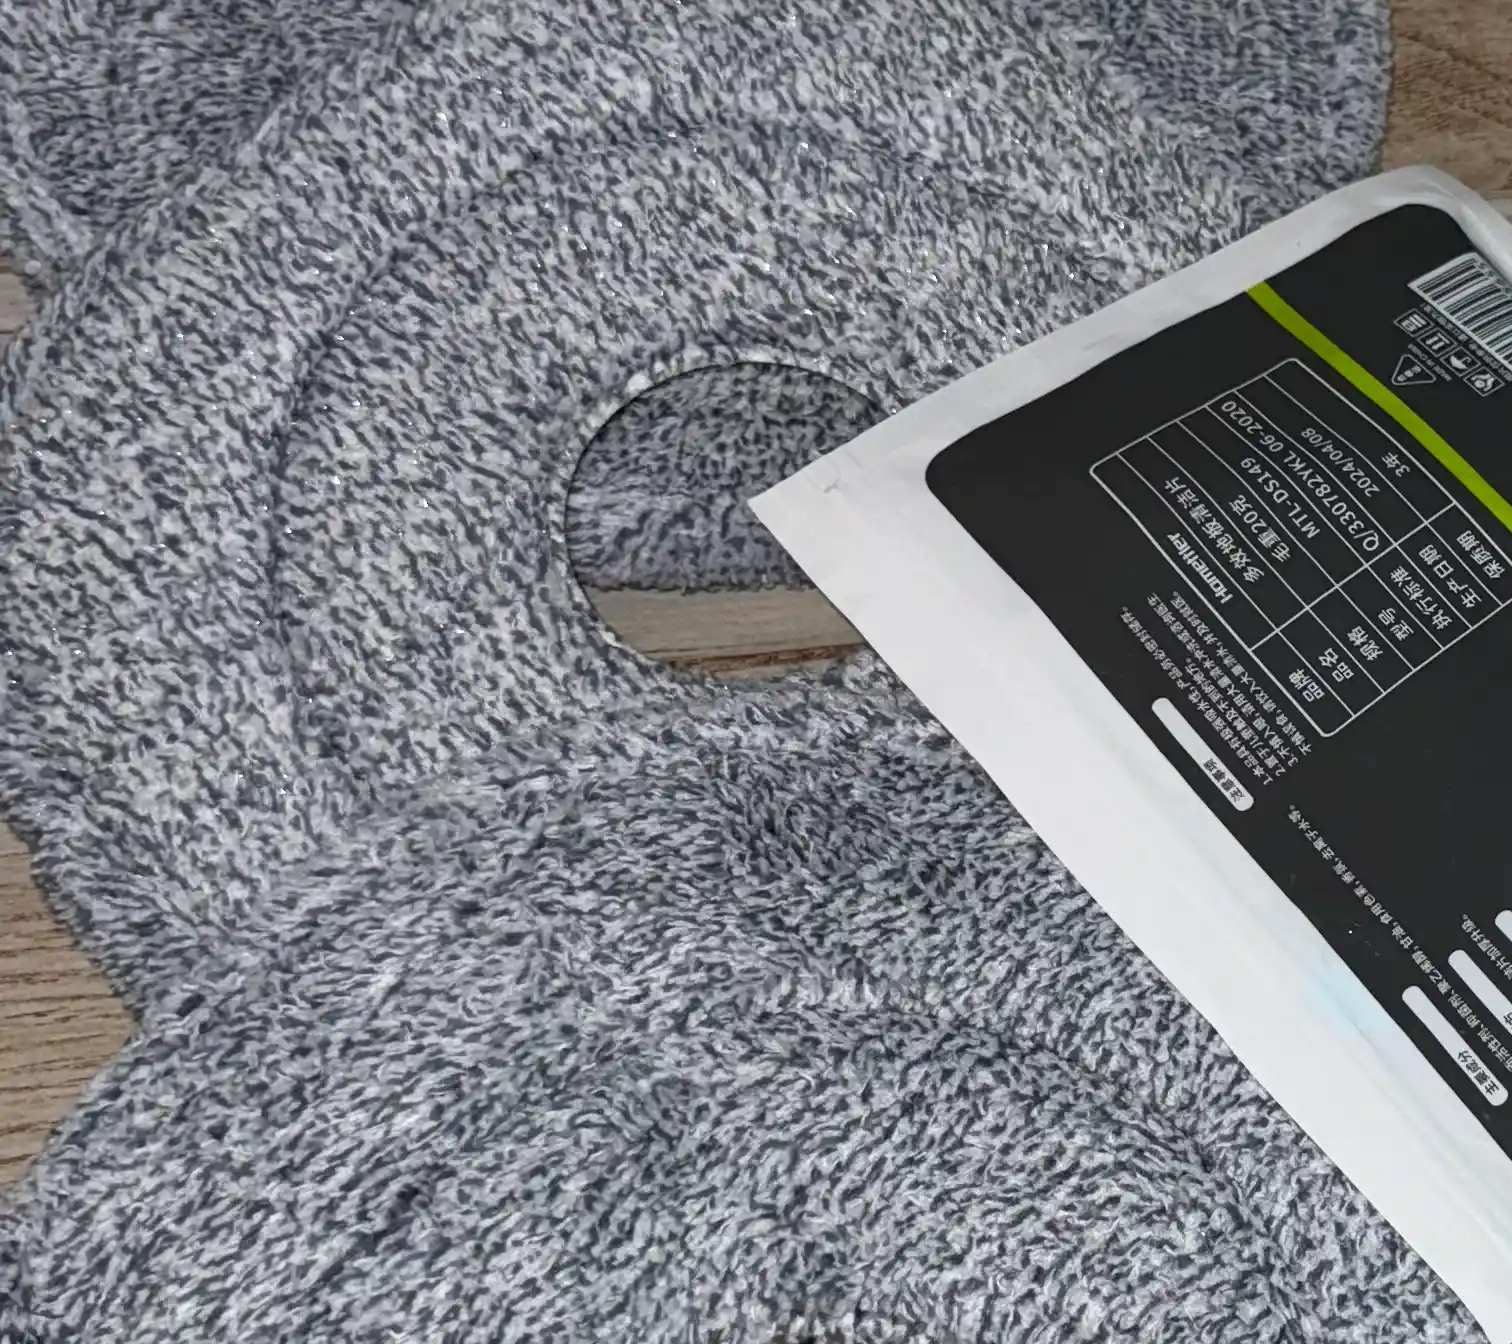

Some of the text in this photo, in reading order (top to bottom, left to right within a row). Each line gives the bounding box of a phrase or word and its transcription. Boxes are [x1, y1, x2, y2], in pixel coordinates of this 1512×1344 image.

[1221, 401, 1379, 551] Q/330782YKL 06-2020
[1301, 428, 1380, 497] 2024/04/08
[1382, 452, 1410, 477] 3年
[1241, 458, 1320, 538] MTL-DS149
[1165, 477, 1264, 582] 多效地板清洁片
[1229, 495, 1290, 562] 毛重20克
[1457, 531, 1505, 578] 保质期
[1168, 533, 1233, 603] Homettler
[1419, 545, 1482, 608] 生产日期
[1378, 608, 1414, 640] 型号
[1391, 566, 1452, 629] 执行标准
[1319, 648, 1354, 682] 品名
[1347, 626, 1383, 660] 规格
[1289, 669, 1324, 702] 品牌
[1204, 758, 1244, 802] 注意事项
[1458, 1051, 1499, 1095] 主要成分
